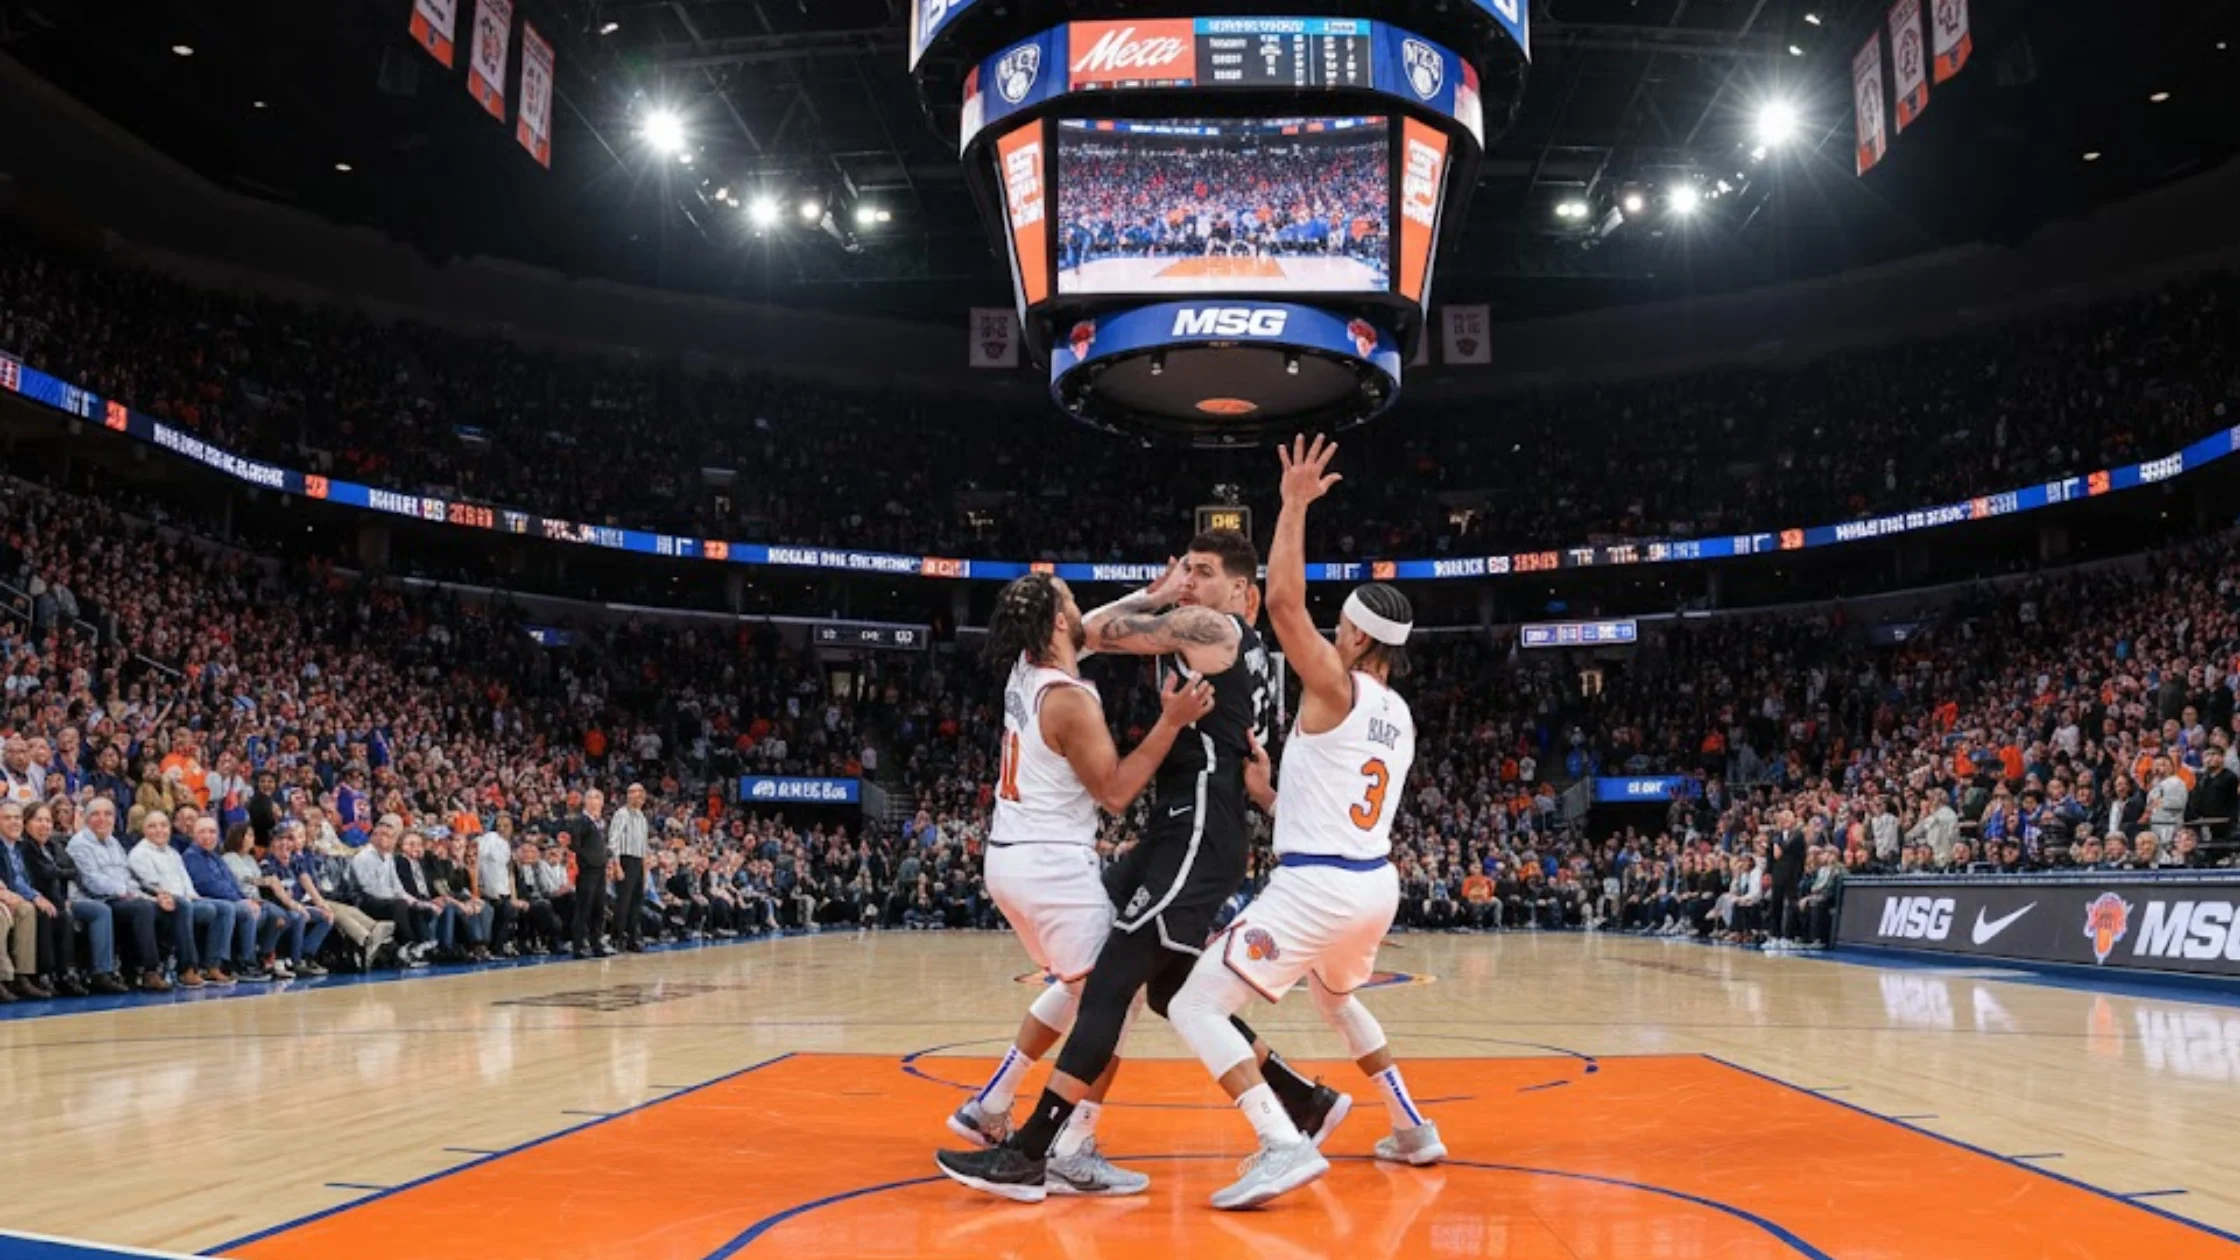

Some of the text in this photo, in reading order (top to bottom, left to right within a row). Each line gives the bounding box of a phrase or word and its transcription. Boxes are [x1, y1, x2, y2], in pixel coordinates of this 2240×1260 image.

[1172, 308, 1287, 336] MSG
[1349, 757, 1389, 832] 3
[1878, 896, 1956, 941] MSG
